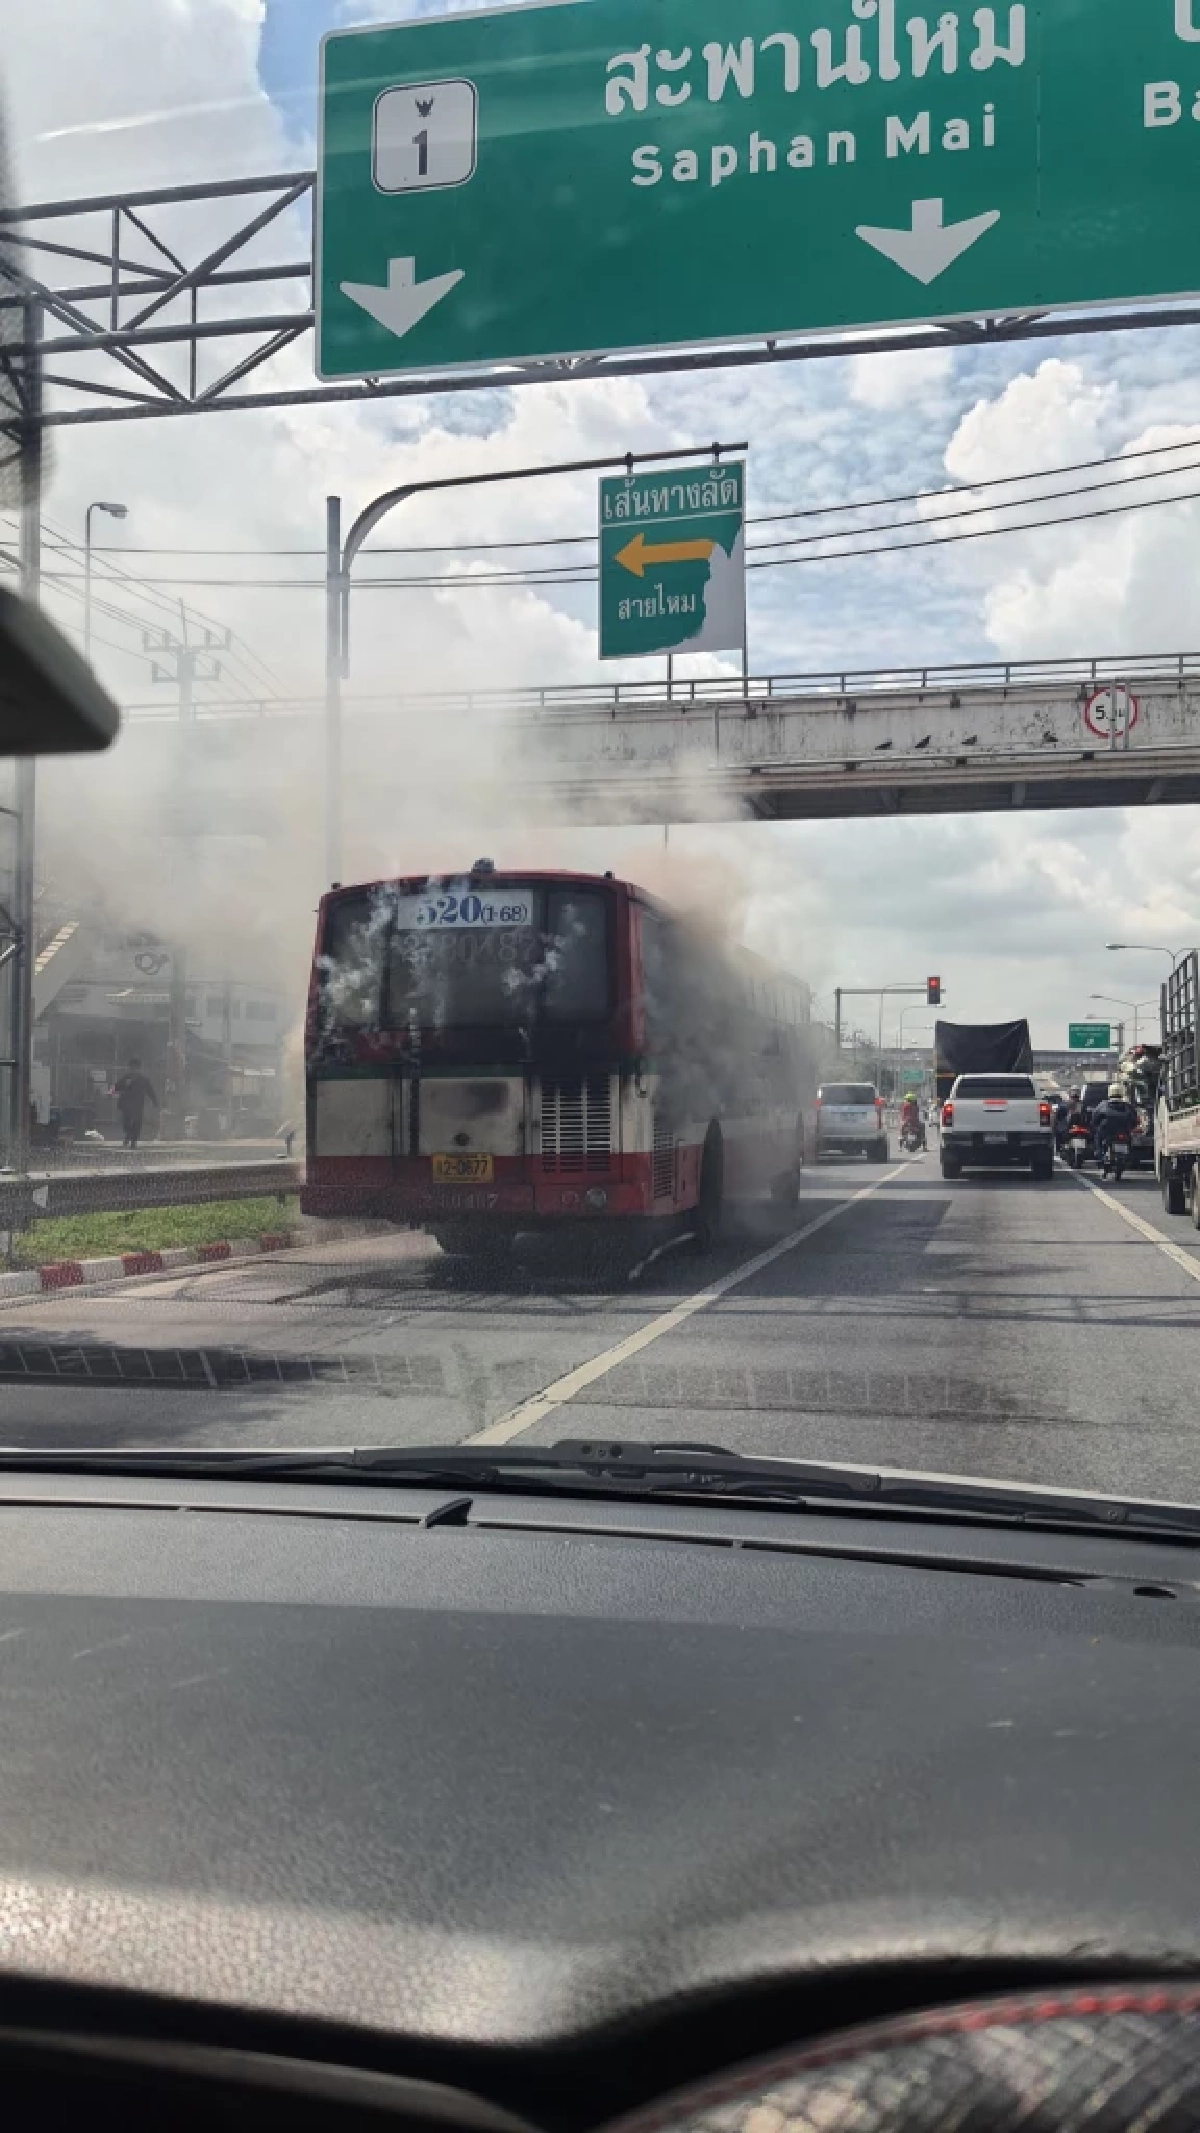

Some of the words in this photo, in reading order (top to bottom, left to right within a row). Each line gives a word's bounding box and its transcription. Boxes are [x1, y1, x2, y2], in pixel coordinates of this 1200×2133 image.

[411, 129, 428, 176] 1
[631, 130, 856, 188] Saphan
[886, 102, 995, 159] Mai
[604, 468, 738, 520] เส้นทางลัด
[618, 583, 696, 620] สายไหม
